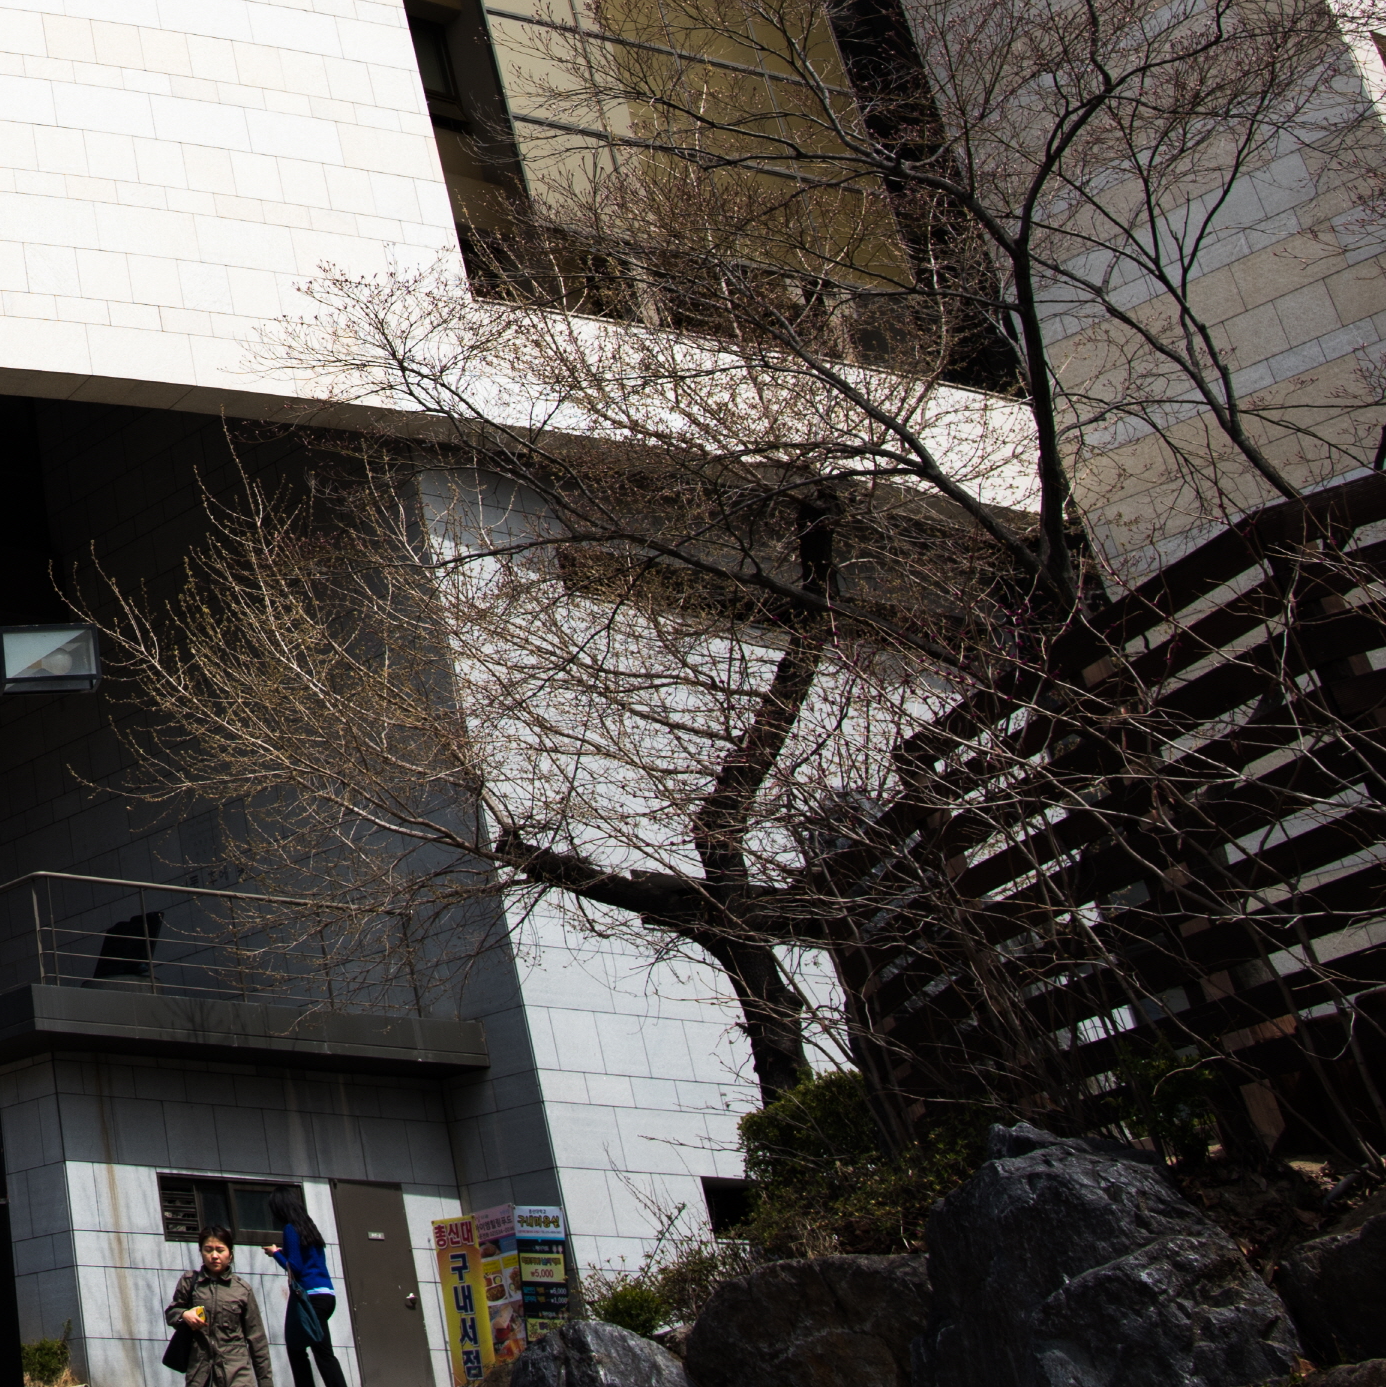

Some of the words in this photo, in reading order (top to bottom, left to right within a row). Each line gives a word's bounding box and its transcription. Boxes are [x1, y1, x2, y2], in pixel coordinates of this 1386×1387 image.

[434, 1220, 475, 1249] 총신대
[517, 1214, 561, 1228] 구내미용실
[449, 1252, 484, 1380] 구내서점
